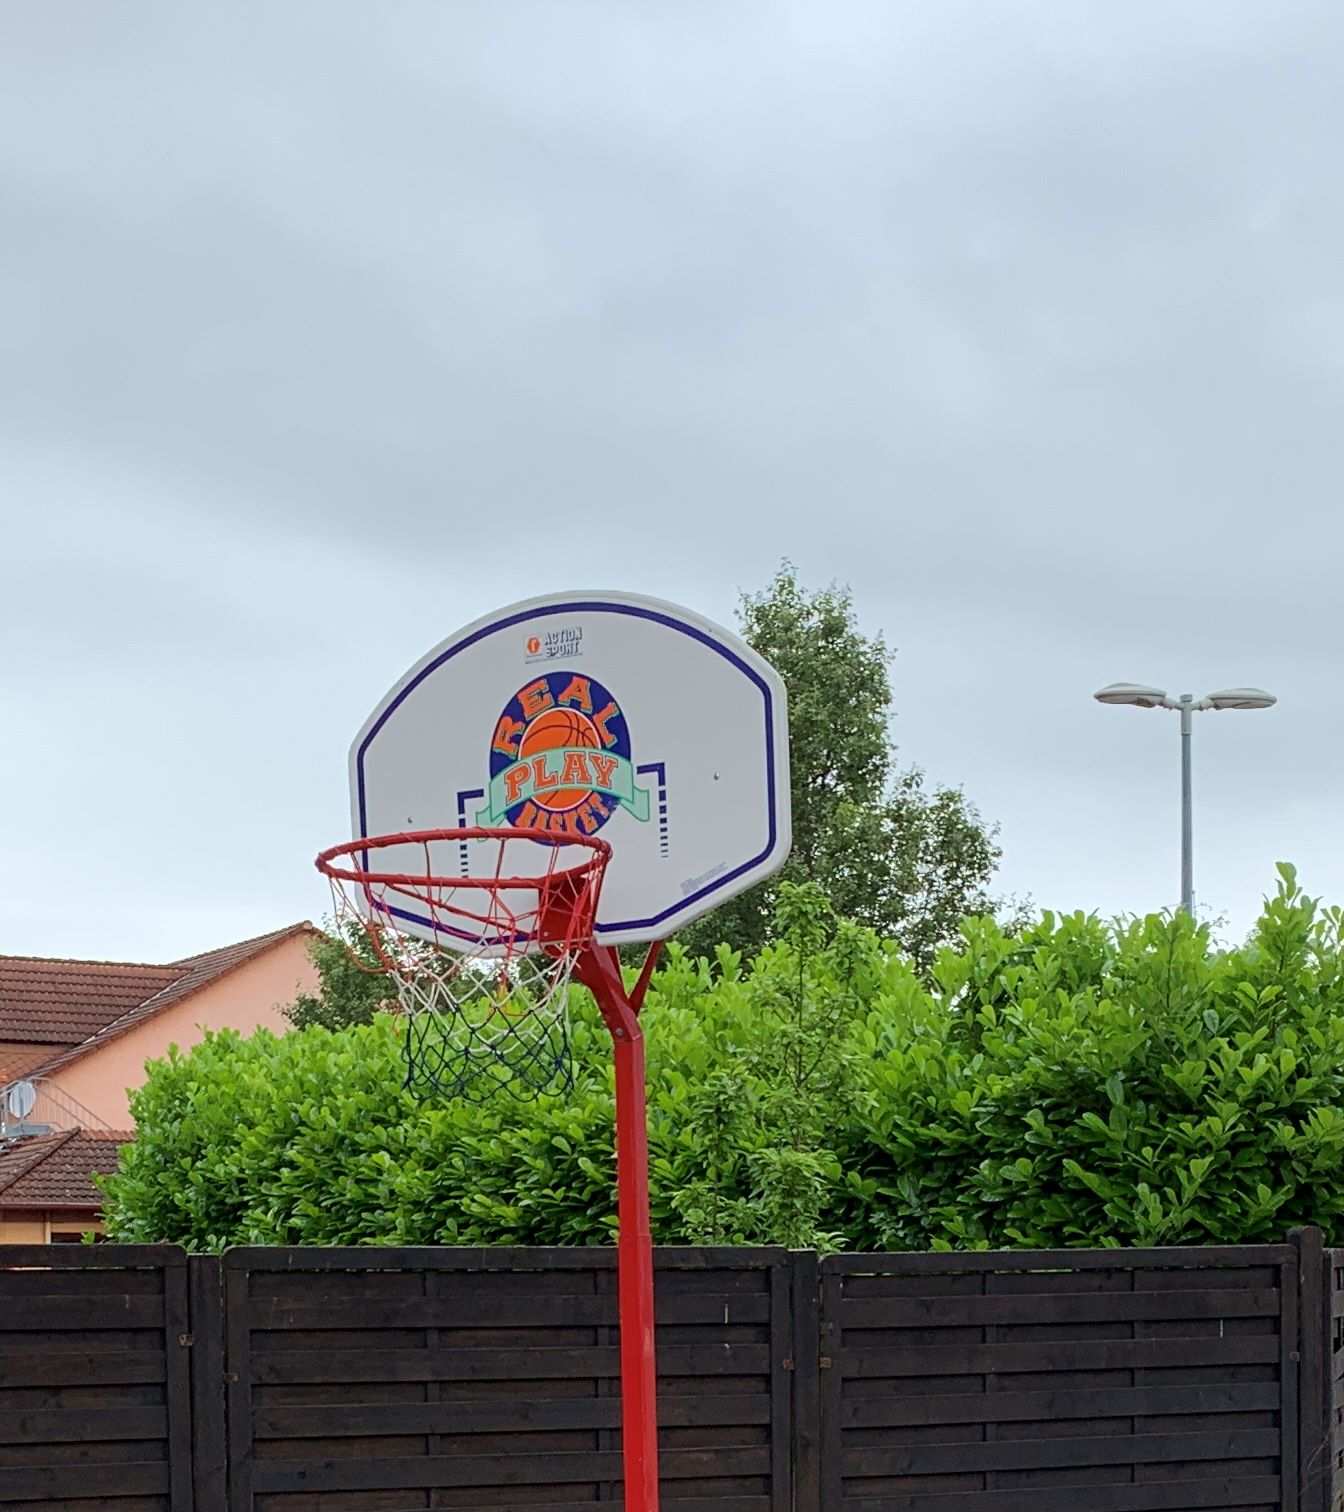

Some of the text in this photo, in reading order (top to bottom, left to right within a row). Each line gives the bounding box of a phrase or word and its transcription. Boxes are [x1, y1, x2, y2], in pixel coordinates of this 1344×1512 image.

[544, 627, 582, 646] ACTION
[545, 640, 582, 657] SPORT
[492, 675, 620, 760] REAL
[504, 750, 619, 806] PLAY
